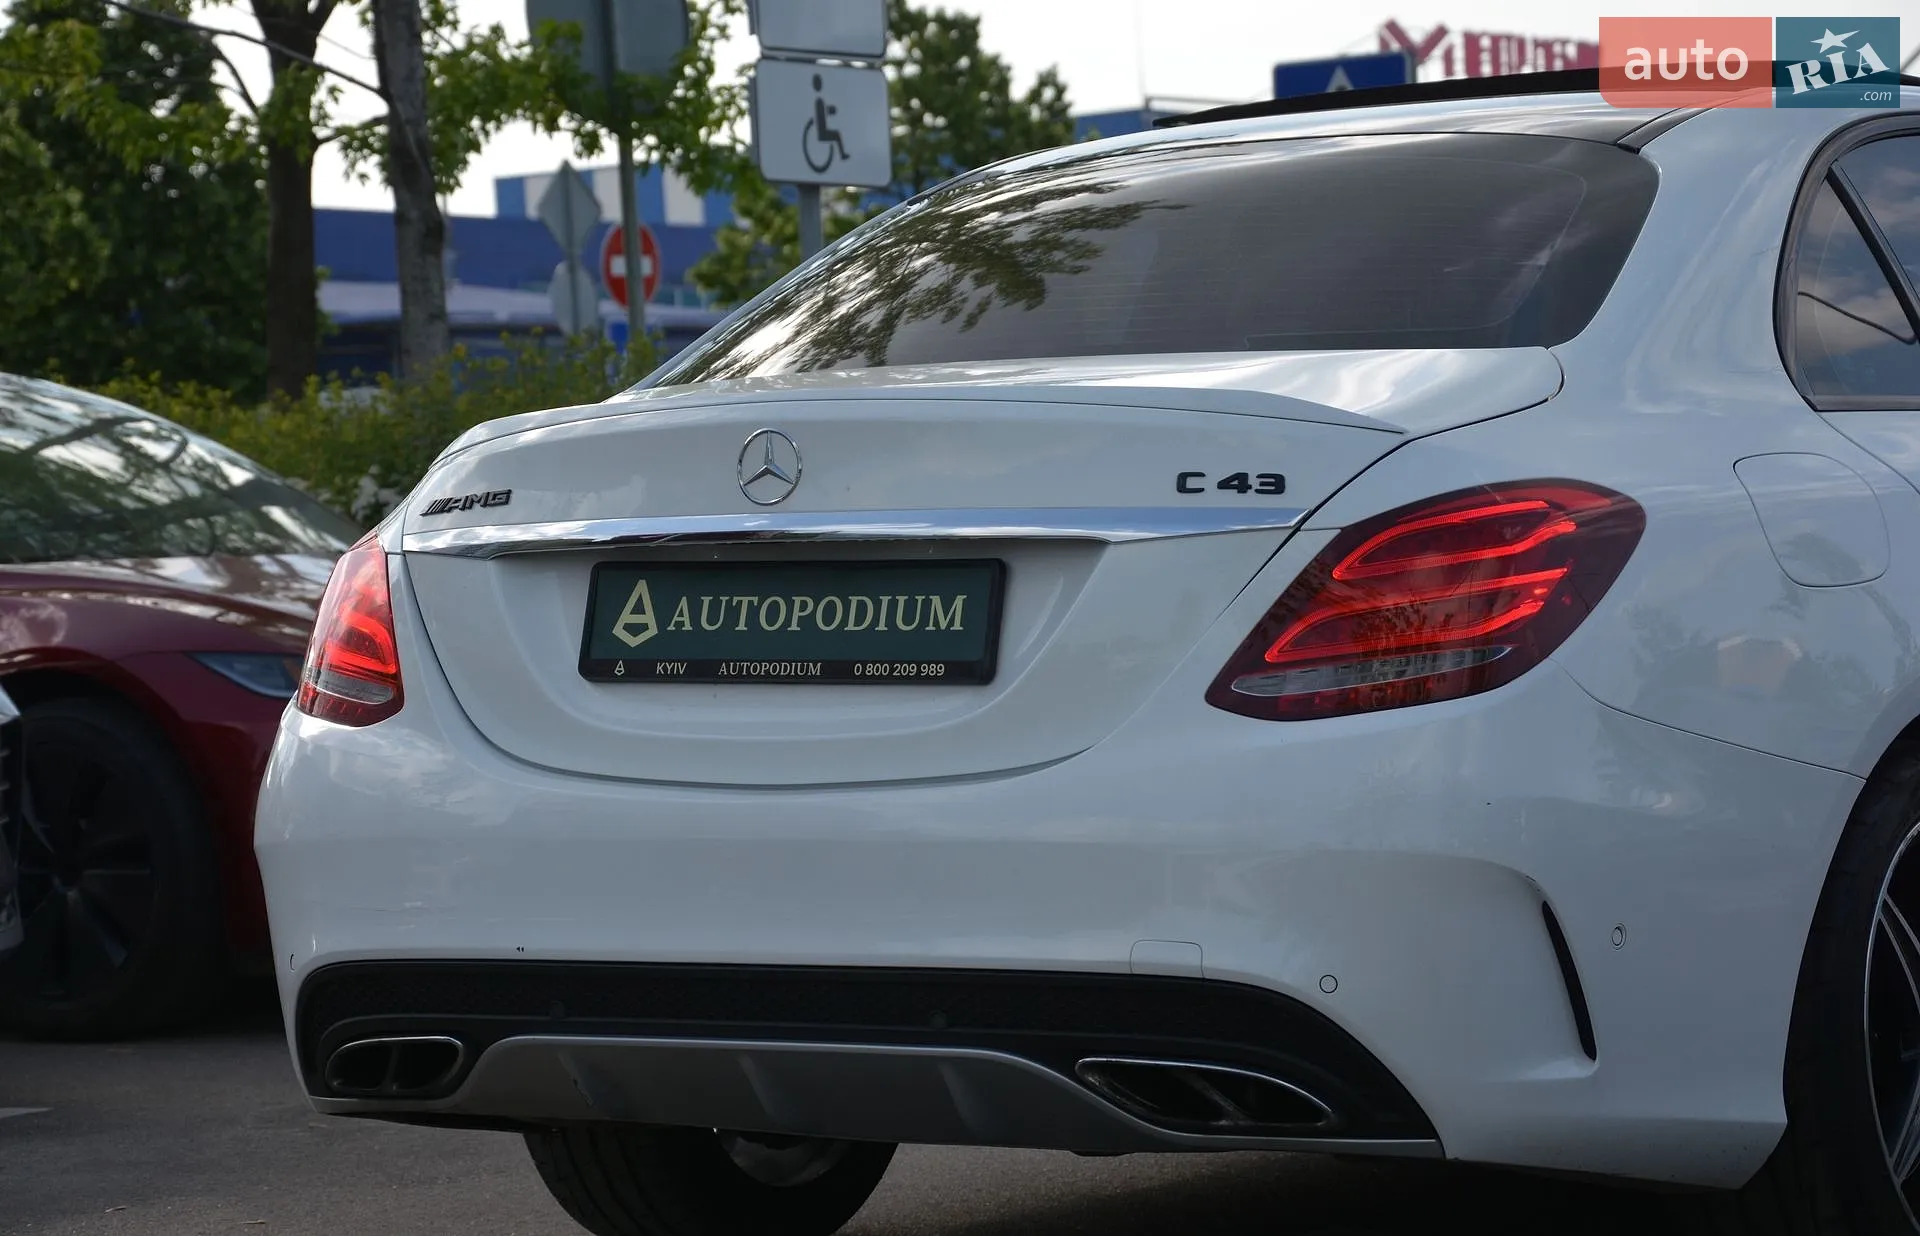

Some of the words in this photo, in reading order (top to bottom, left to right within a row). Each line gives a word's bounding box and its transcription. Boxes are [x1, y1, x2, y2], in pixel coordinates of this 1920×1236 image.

[1176, 471, 1206, 494] C
[1216, 471, 1286, 495] 43
[667, 594, 967, 632] AUTOPODIUM
[655, 662, 688, 675] KYIV
[718, 662, 823, 676] AUTOPODIUM
[853, 663, 863, 676] 0
[865, 663, 890, 676] 800
[892, 663, 917, 676] 209
[920, 663, 945, 676] 989
